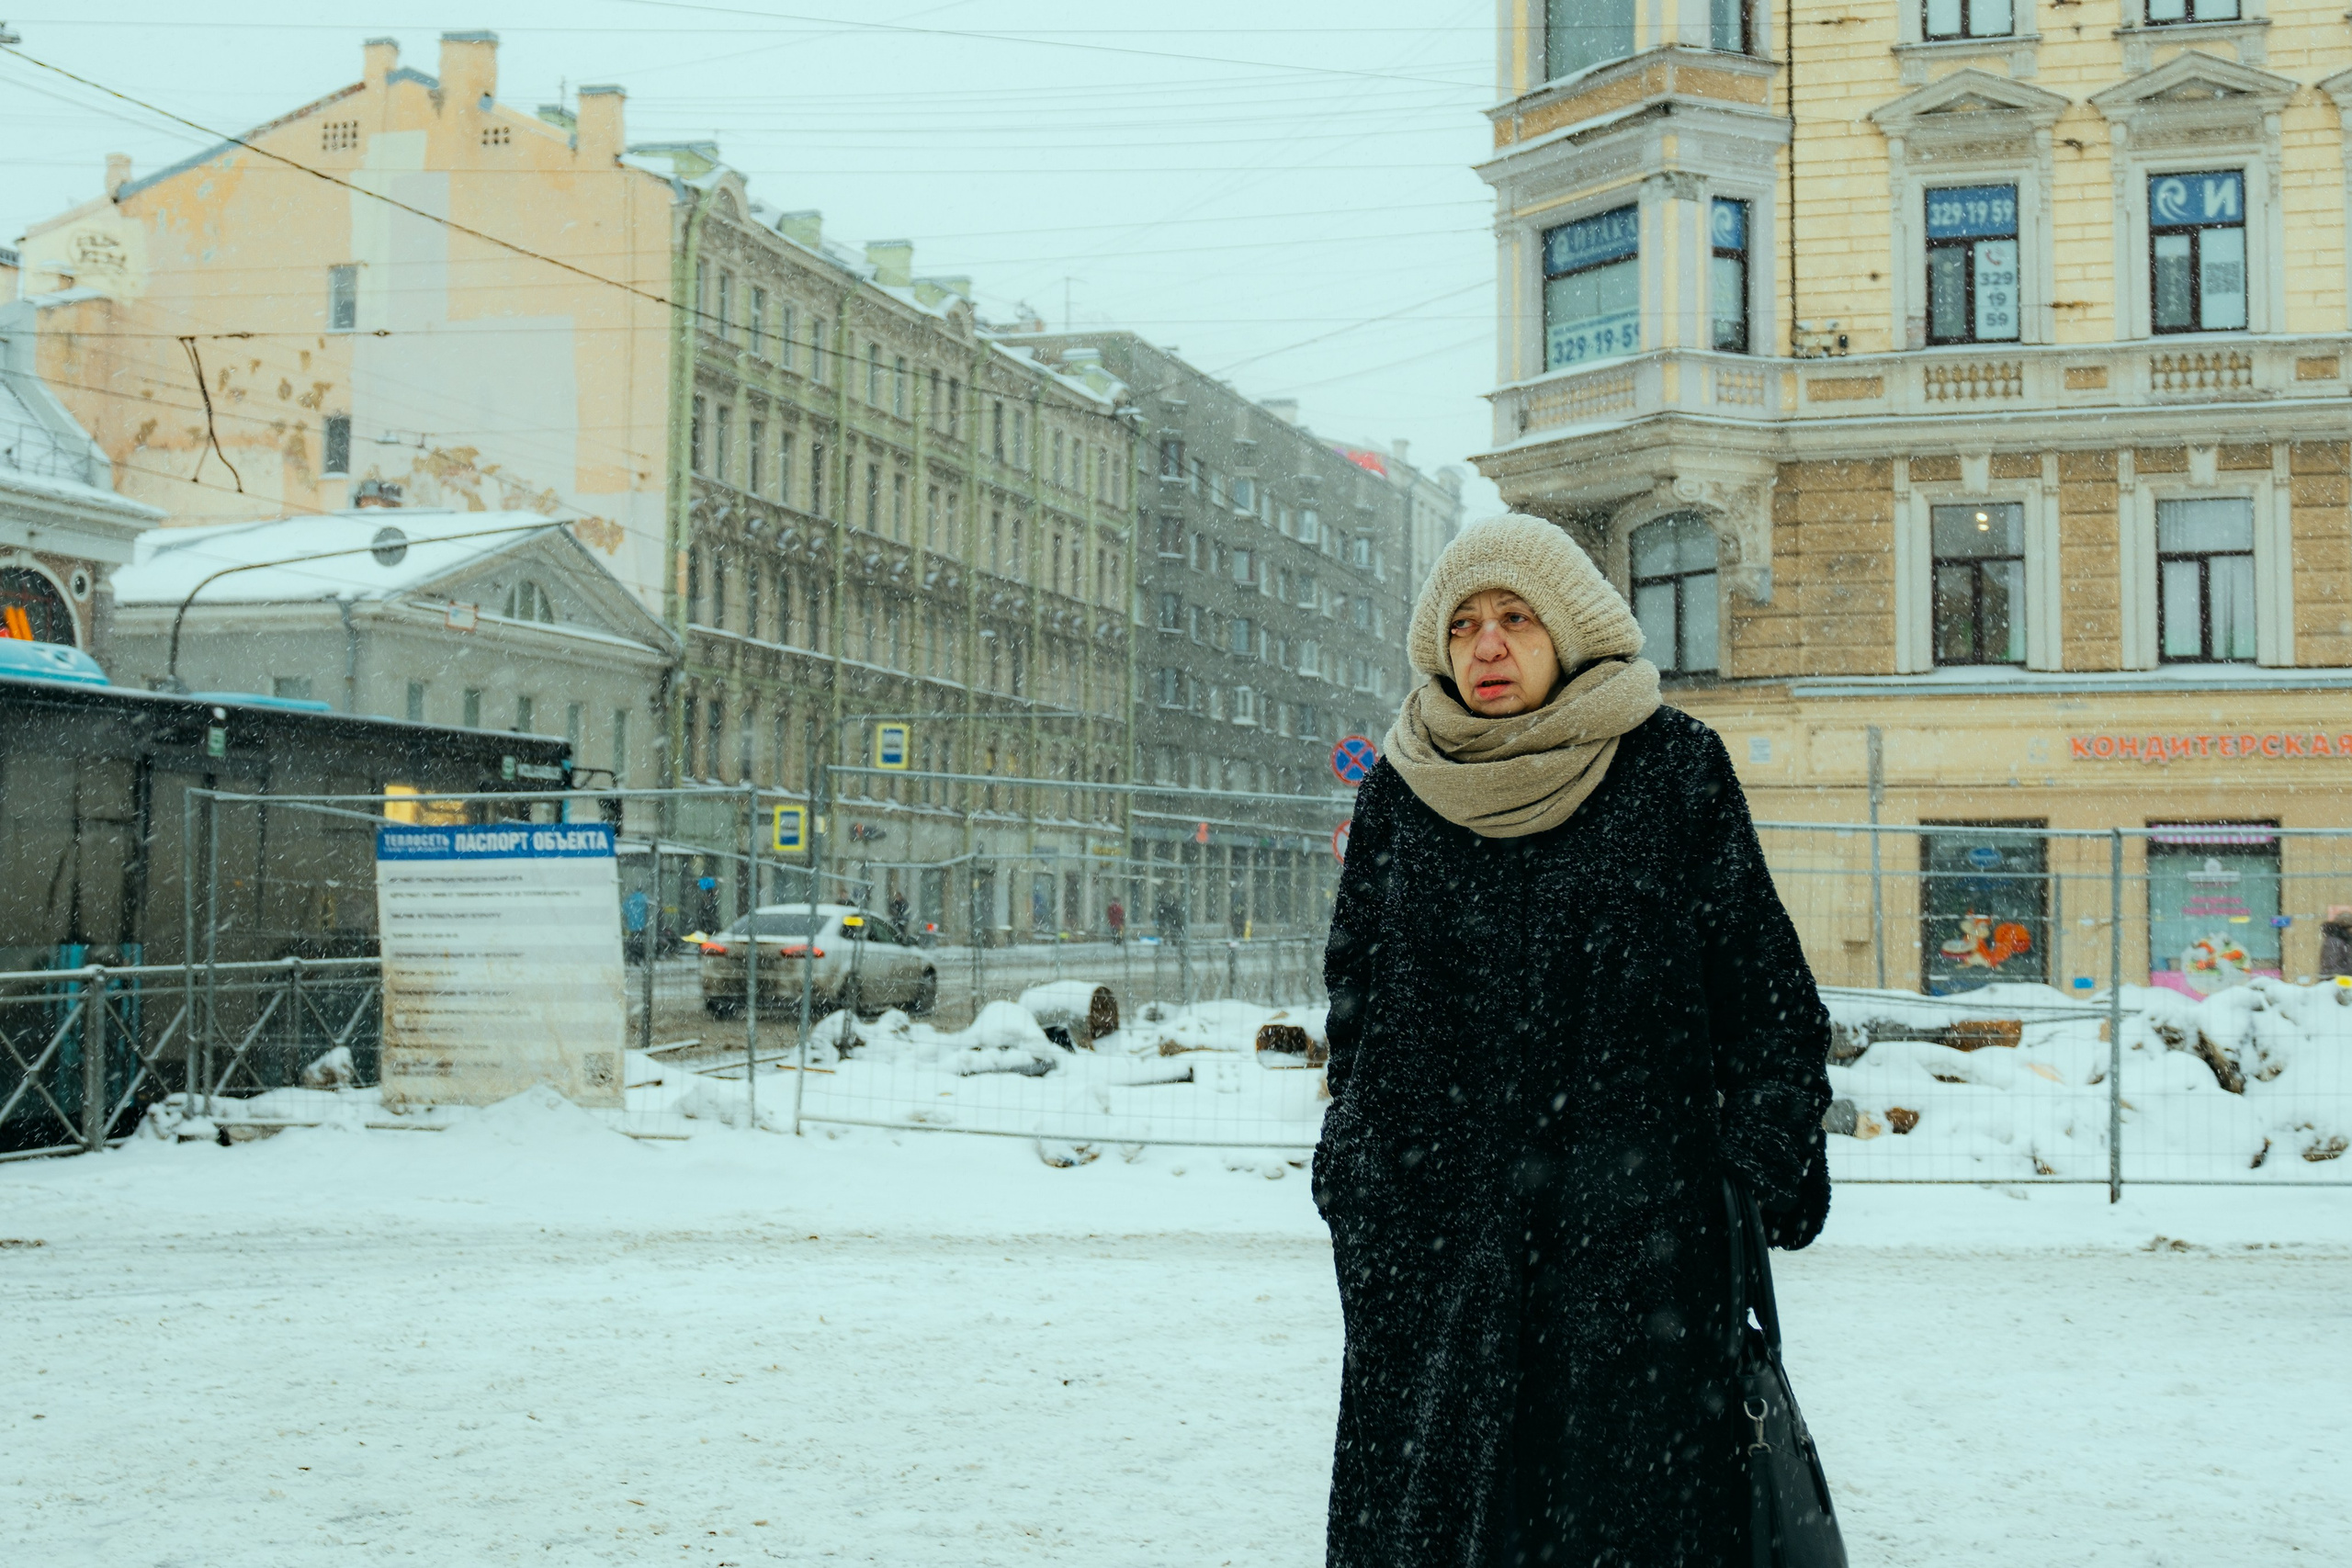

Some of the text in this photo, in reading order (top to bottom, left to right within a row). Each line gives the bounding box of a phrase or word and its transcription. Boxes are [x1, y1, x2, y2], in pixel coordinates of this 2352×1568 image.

[1930, 198, 2014, 226] 329 19 59
[1980, 271, 2014, 286] 329
[1987, 292, 2007, 307] 19
[1986, 312, 2009, 327] 59
[2071, 734, 2352, 762] КОНДИТЕРСКАЯ
[455, 829, 609, 852] ПАСПОРТ ОБЪЕКТА
